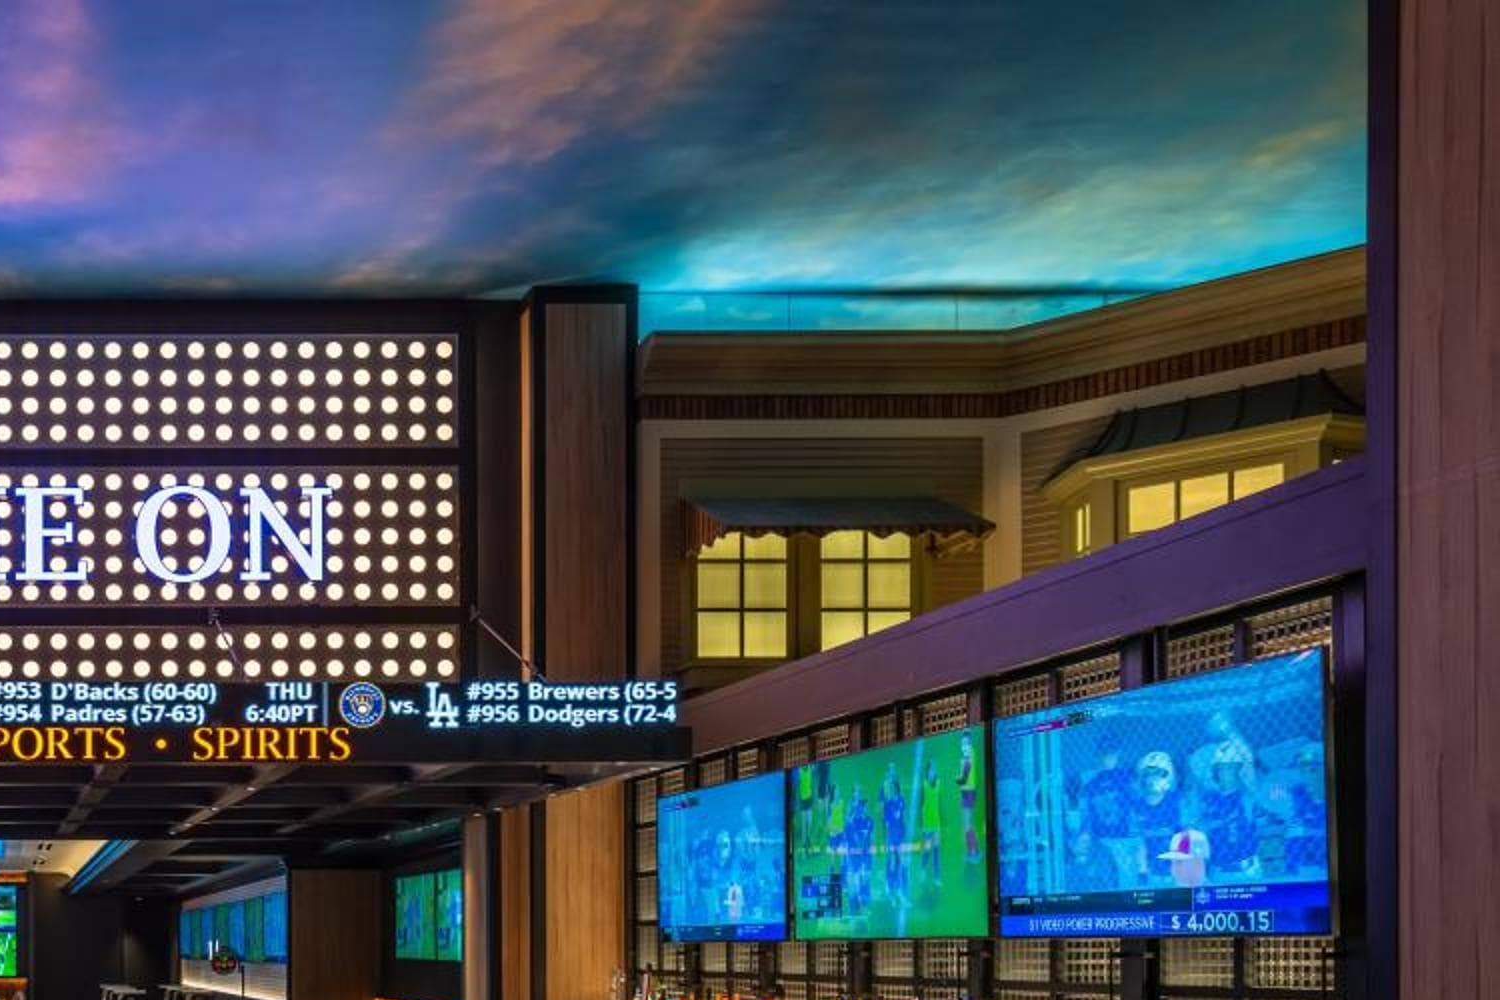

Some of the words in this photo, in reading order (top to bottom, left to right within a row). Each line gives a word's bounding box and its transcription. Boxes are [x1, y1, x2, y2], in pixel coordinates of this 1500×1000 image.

[133, 484, 333, 584] ON
[51, 682, 139, 701] D'Backs
[144, 683, 217, 704] (60-60)
[264, 682, 312, 700] THU
[467, 682, 520, 700] #955
[528, 682, 620, 700] Brewers
[51, 704, 127, 722] Padres
[132, 705, 205, 726] (57-63)
[245, 704, 317, 722] 6:40PT
[389, 700, 420, 715] vs.
[467, 704, 520, 722] #956
[528, 704, 619, 727] Dodgers
[193, 726, 351, 761] SPIRITS
[1095, 916, 1155, 931] PROGRESSIVE
[1187, 912, 1270, 932] 4,000.15
